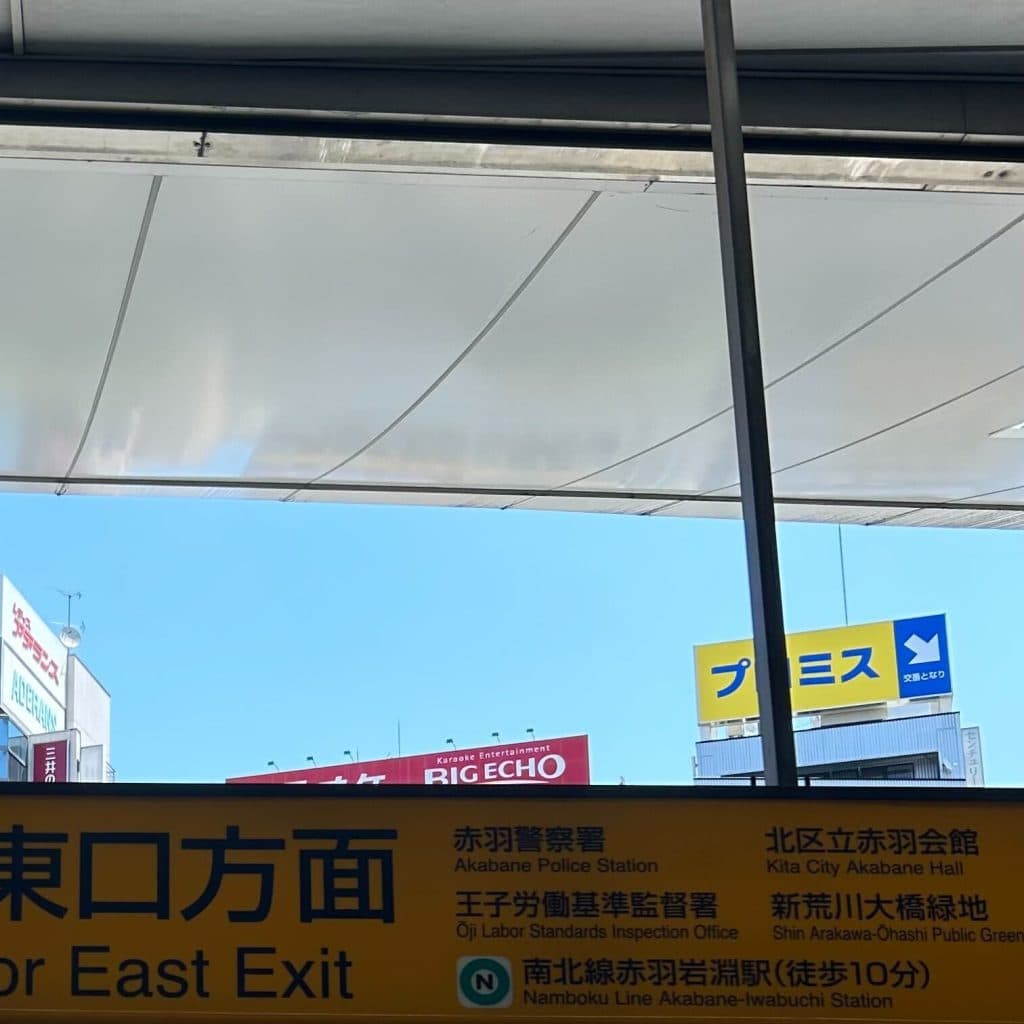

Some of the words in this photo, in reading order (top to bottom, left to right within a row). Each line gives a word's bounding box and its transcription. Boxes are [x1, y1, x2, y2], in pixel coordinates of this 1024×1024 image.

[711, 646, 881, 698] プミス
[903, 670, 945, 683] 交番となり
[11, 669, 58, 732] ADERANS
[436, 753, 475, 765] Karaoke
[479, 744, 551, 760] Entertainment
[424, 764, 479, 785] BIG
[484, 754, 566, 779] ECHO
[453, 826, 606, 853] 赤羽警察署
[764, 826, 980, 857] 北区立赤羽会館
[454, 858, 531, 873] Akabane
[538, 858, 591, 873] Police
[597, 858, 658, 873] Station
[767, 859, 800, 874] Kita
[806, 859, 840, 878] City
[847, 860, 924, 875] Akabane
[930, 861, 964, 876] Hall
[456, 890, 718, 919] 王子労働基準監督署
[771, 892, 989, 921] 新荒川大橋緑地
[482, 924, 525, 939] Labor
[529, 924, 607, 939] Standards
[612, 924, 689, 943] Inspection
[693, 925, 739, 940] Office
[773, 926, 805, 941] Shin
[932, 927, 976, 943] Public
[980, 927, 1024, 943] Green
[71, 946, 210, 998] East
[236, 947, 353, 999] Exit
[475, 973, 494, 990] N
[523, 990, 610, 1005] Namboku
[615, 991, 652, 1006] Line
[658, 991, 825, 1008] Akabane-Iwabuchi
[831, 993, 893, 1008] Station
